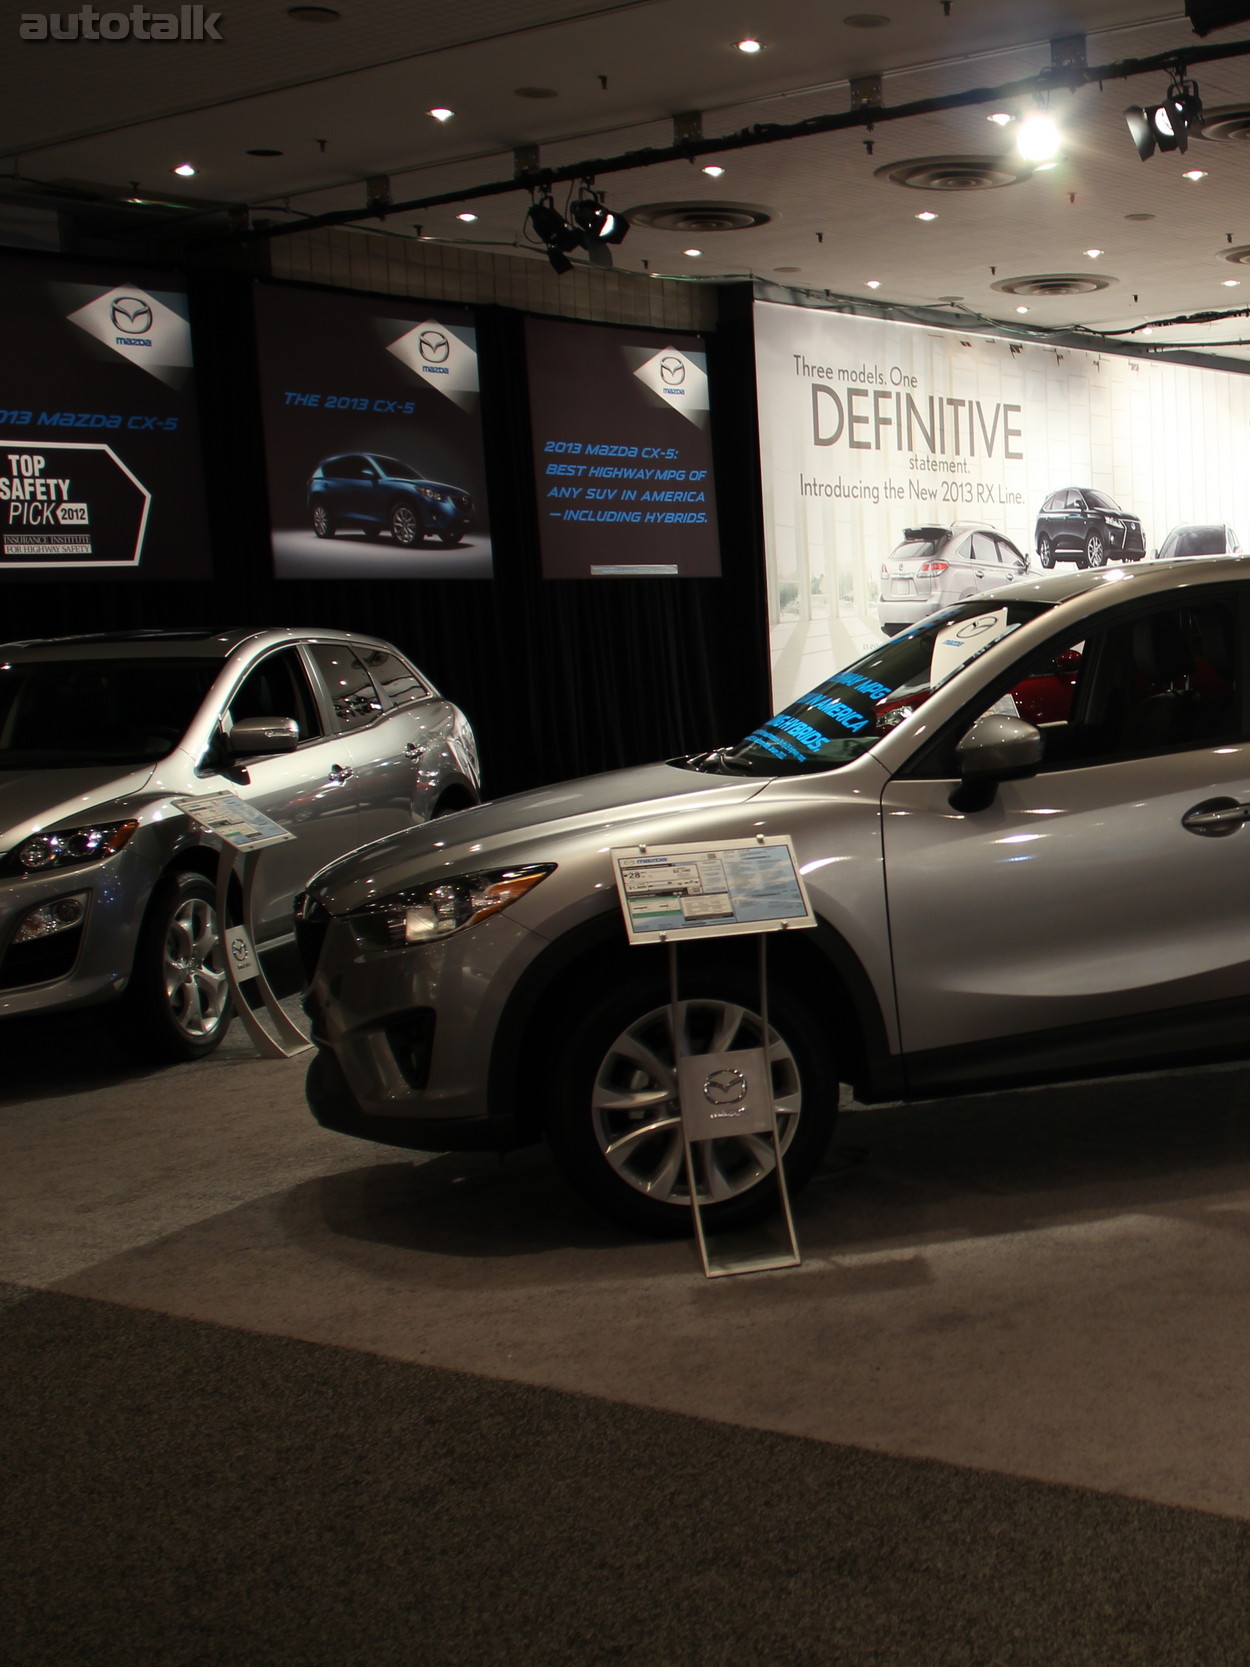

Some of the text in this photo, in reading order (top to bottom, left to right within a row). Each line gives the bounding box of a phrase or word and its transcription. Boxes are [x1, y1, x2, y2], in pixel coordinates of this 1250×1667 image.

[116, 336, 152, 347] mazda
[422, 365, 450, 375] mazda
[793, 354, 918, 388] Three models. One
[662, 387, 686, 395] mazda
[284, 391, 415, 414] THE 2013 CX-5
[0, 410, 179, 431] 013 Mazda CX-5
[811, 383, 1024, 459] DEFINITIVE
[544, 441, 679, 459] 2013 Mazda CX-5:
[8, 454, 46, 477] TOP
[545, 463, 708, 481] BEST HIGHWAY MPG OF
[909, 454, 971, 474] statement.
[0, 477, 70, 501] SAFETY
[547, 487, 706, 502] ANY SUV IN AMERICA
[800, 473, 1026, 505] Introducing the New 2013 RX Line.
[9, 502, 86, 525] PICK 2012
[644, 512, 708, 523] HYBRIDS.
[6, 545, 90, 553] FOR HIGHWAY SAFETY
[854, 679, 893, 700] MPG
[815, 696, 869, 734] AMERICA
